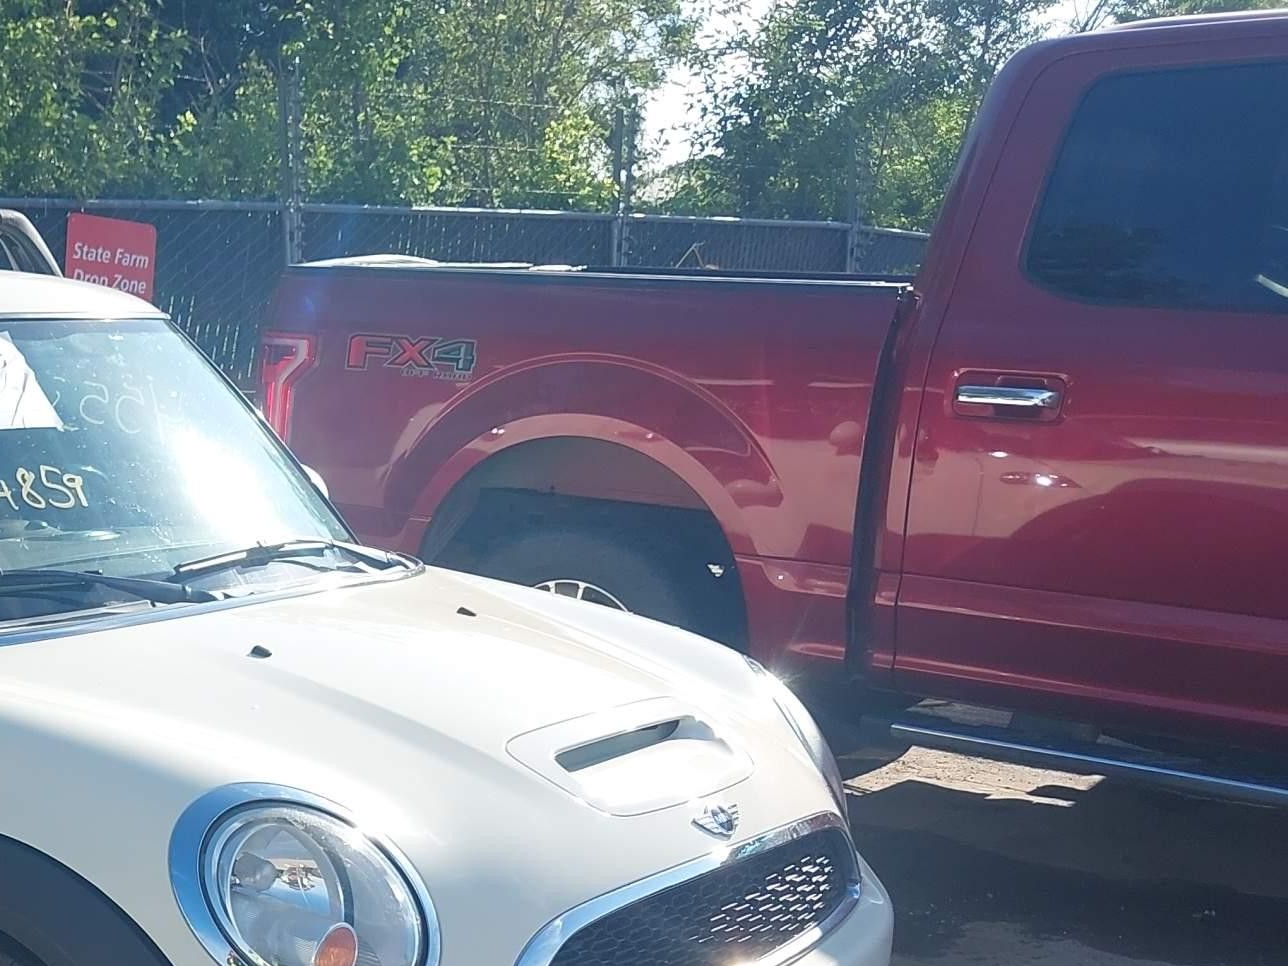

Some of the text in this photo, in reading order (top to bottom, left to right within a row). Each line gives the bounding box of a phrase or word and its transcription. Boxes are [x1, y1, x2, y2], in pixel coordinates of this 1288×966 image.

[72, 241, 150, 269] State Farm
[112, 273, 147, 294] Zone
[345, 332, 477, 373] FX4
